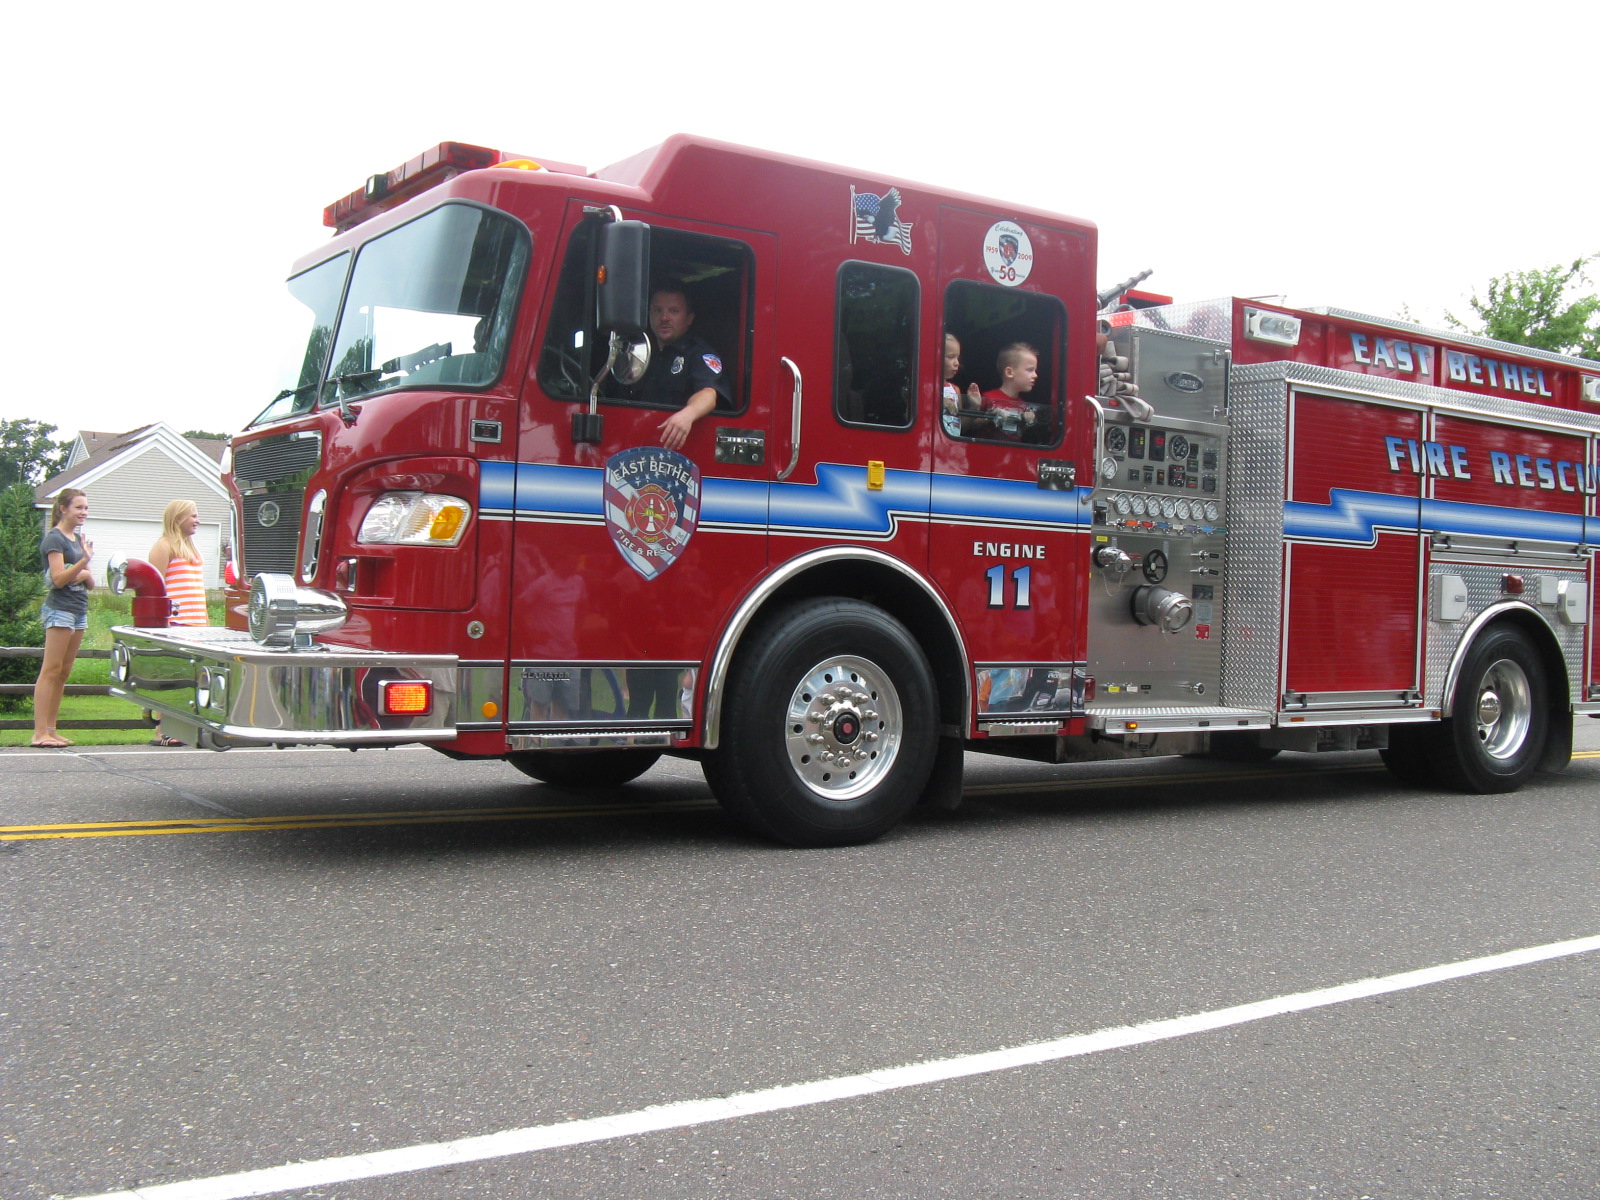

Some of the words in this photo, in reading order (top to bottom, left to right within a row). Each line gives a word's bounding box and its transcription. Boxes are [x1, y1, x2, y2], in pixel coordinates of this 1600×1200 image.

[986, 245, 998, 253] 1959
[999, 265, 1016, 281] 50
[1350, 332, 1431, 376] EAST
[1447, 351, 1552, 397] BETHEL
[612, 460, 645, 482] EAST
[649, 460, 695, 490] BETHEL
[1384, 435, 1471, 482] FIRE
[1489, 450, 1600, 496] RESCU
[616, 529, 636, 551] FIRE
[636, 547, 644, 556] &
[646, 531, 686, 557] RESCUE
[973, 541, 1046, 559] ENGINE
[985, 564, 1031, 609] 11
